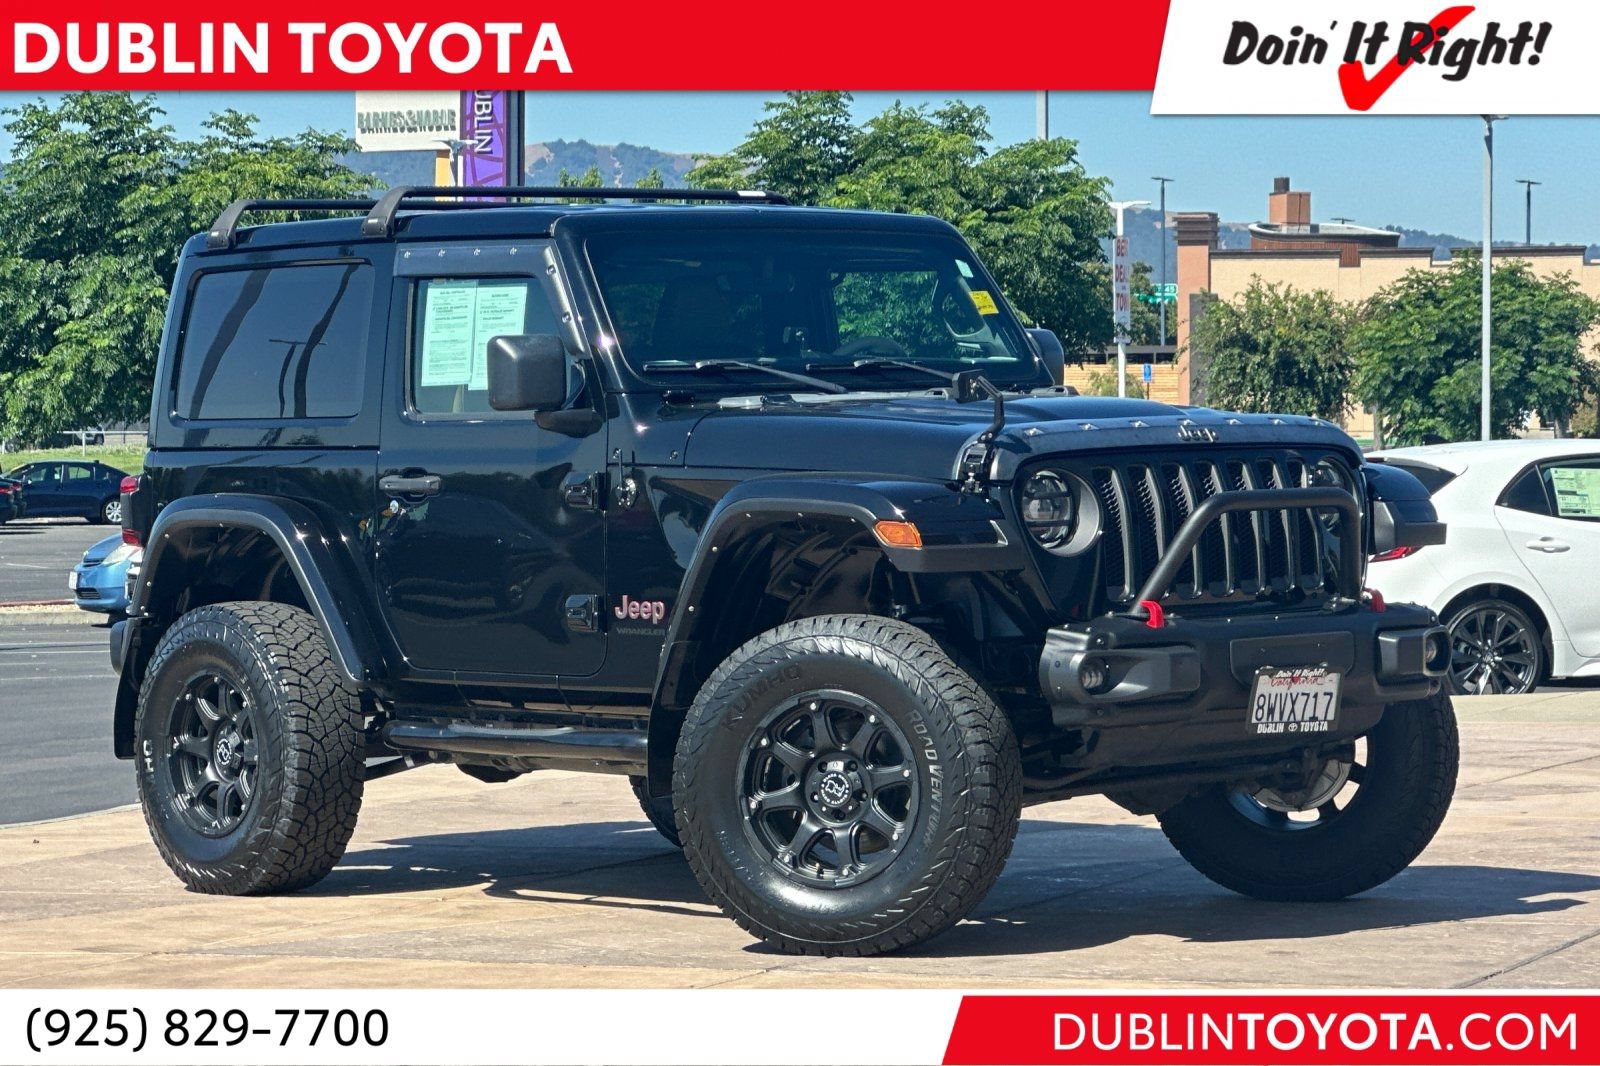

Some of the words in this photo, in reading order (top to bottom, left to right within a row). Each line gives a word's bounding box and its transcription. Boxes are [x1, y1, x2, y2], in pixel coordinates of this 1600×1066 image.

[473, 91, 493, 154] UBLIN
[1177, 425, 1217, 443] Jeep
[614, 594, 665, 625] Jeep
[616, 627, 666, 636] WRANGLER
[1255, 691, 1334, 722] 8WVX717
[1257, 722, 1285, 734] DUBLIN
[1300, 720, 1328, 732] TOYOTA
